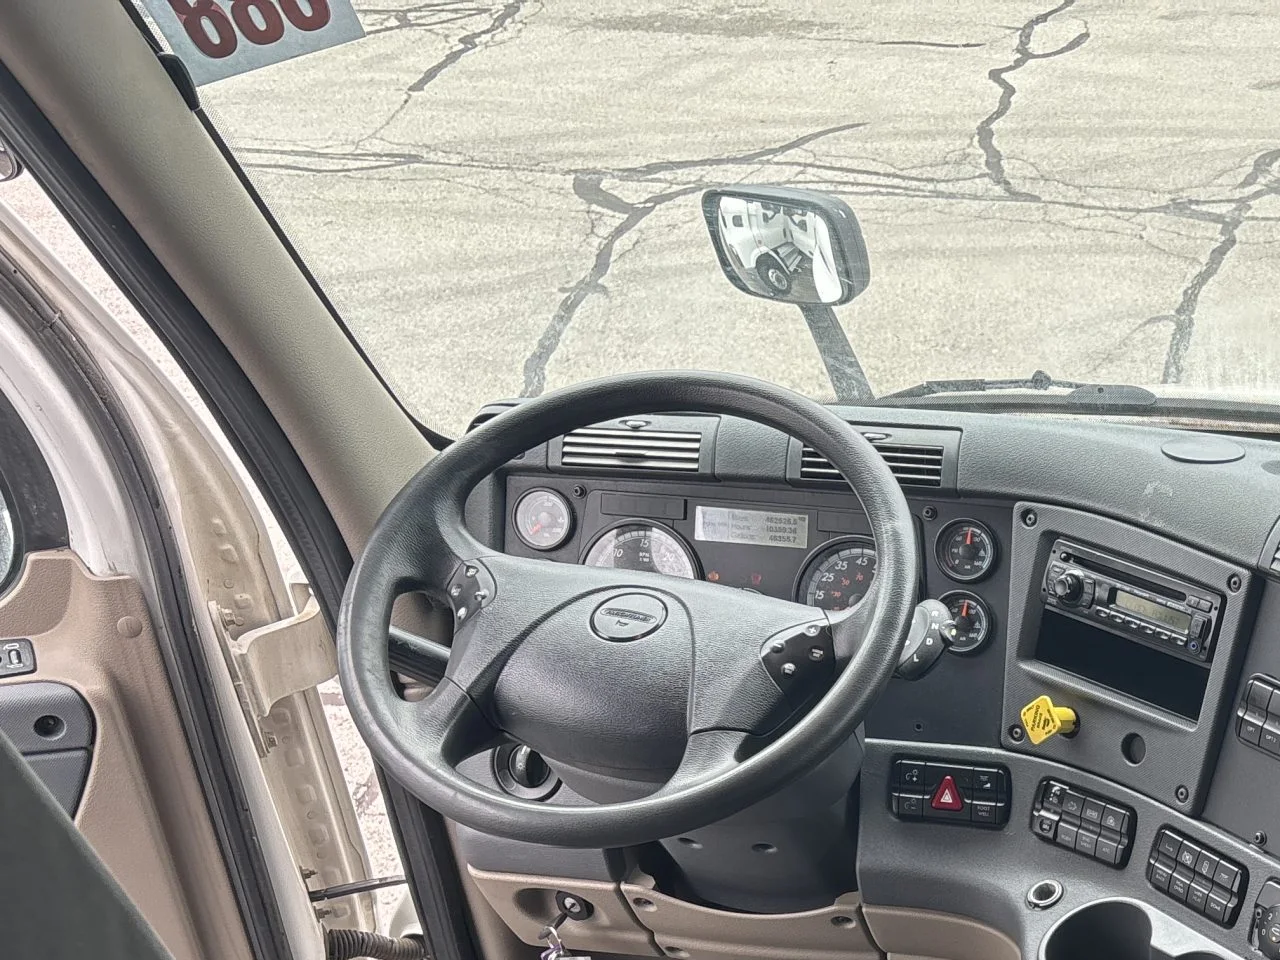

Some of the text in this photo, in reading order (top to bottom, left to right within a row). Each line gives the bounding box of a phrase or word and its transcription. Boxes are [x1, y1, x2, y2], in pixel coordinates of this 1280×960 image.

[639, 539, 649, 548] 15
[835, 561, 848, 570] 35
[856, 557, 868, 566] 45
[822, 572, 835, 582] 25
[815, 590, 825, 599] 15
[926, 638, 933, 646] D
[913, 654, 919, 662] L
